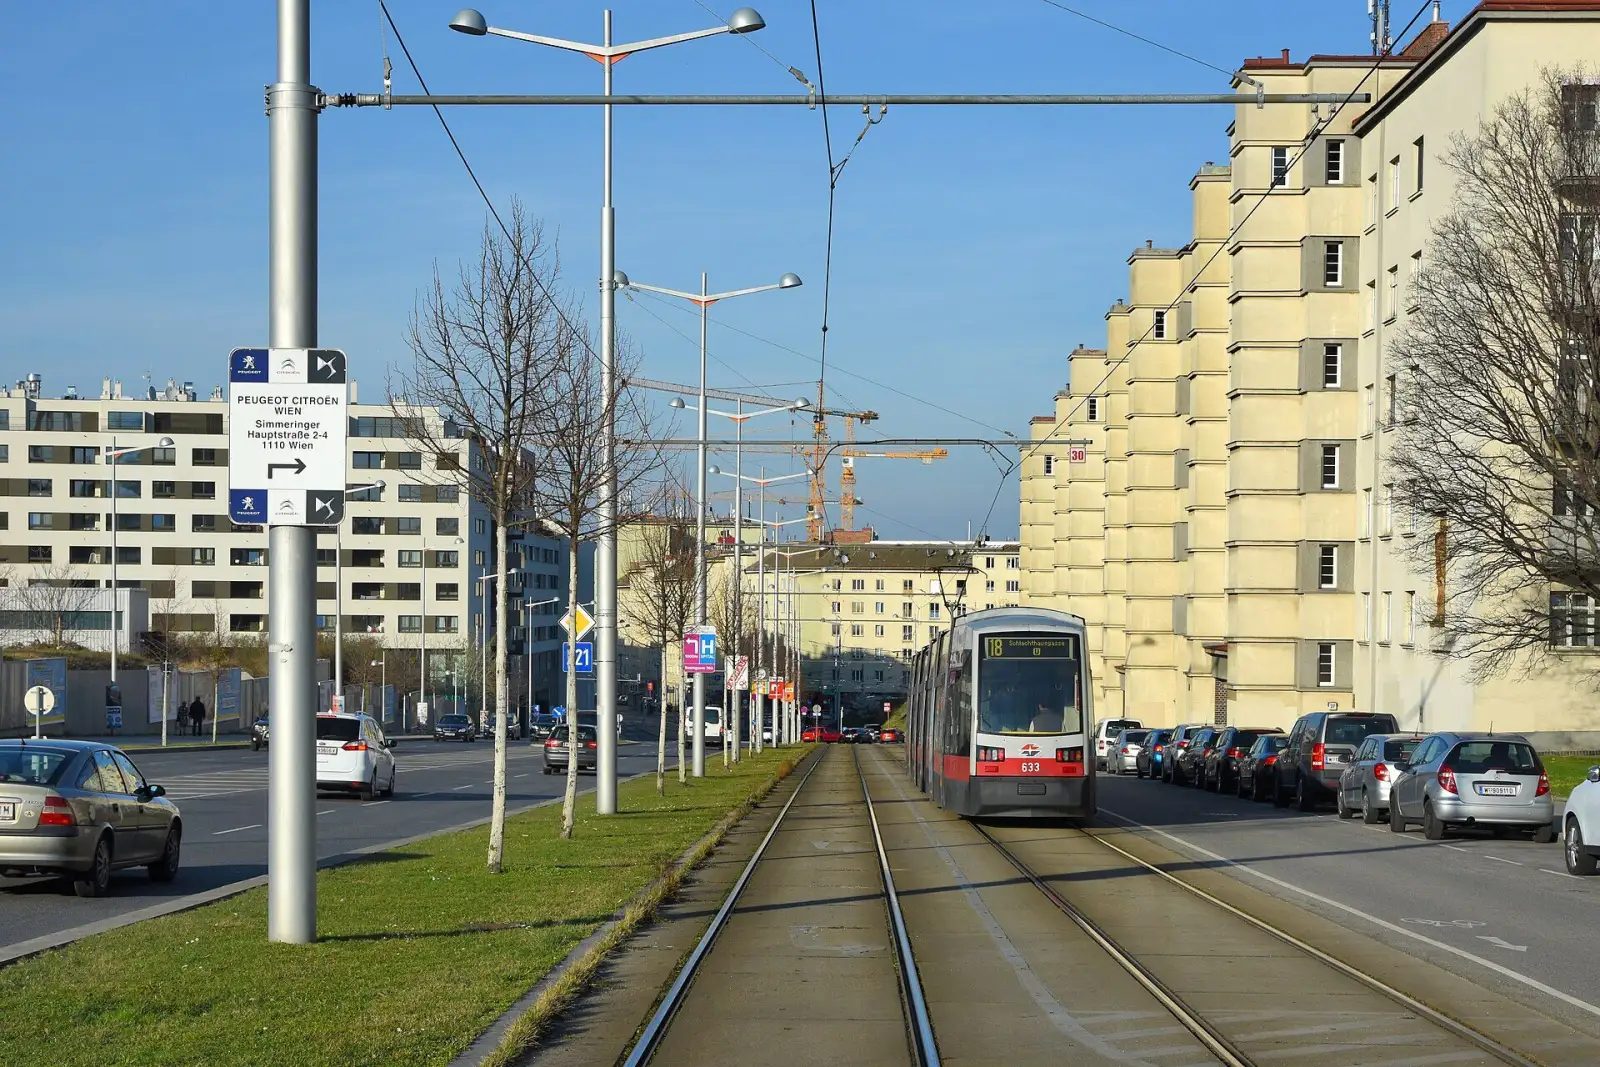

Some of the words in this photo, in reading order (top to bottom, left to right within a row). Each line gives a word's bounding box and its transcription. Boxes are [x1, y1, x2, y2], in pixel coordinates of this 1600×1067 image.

[237, 395, 289, 405] PEUGEOT
[292, 395, 339, 405] CITROËN
[274, 406, 302, 416] WIEN
[255, 419, 321, 431] Simmeringer
[247, 430, 310, 441] Hauptstraße
[312, 431, 328, 440] 2-4
[262, 441, 286, 450] 1110
[288, 441, 314, 450] Wien
[1071, 450, 1084, 461] 30
[701, 639, 714, 655] H
[989, 639, 1003, 657] 18
[1021, 762, 1040, 773] 633
